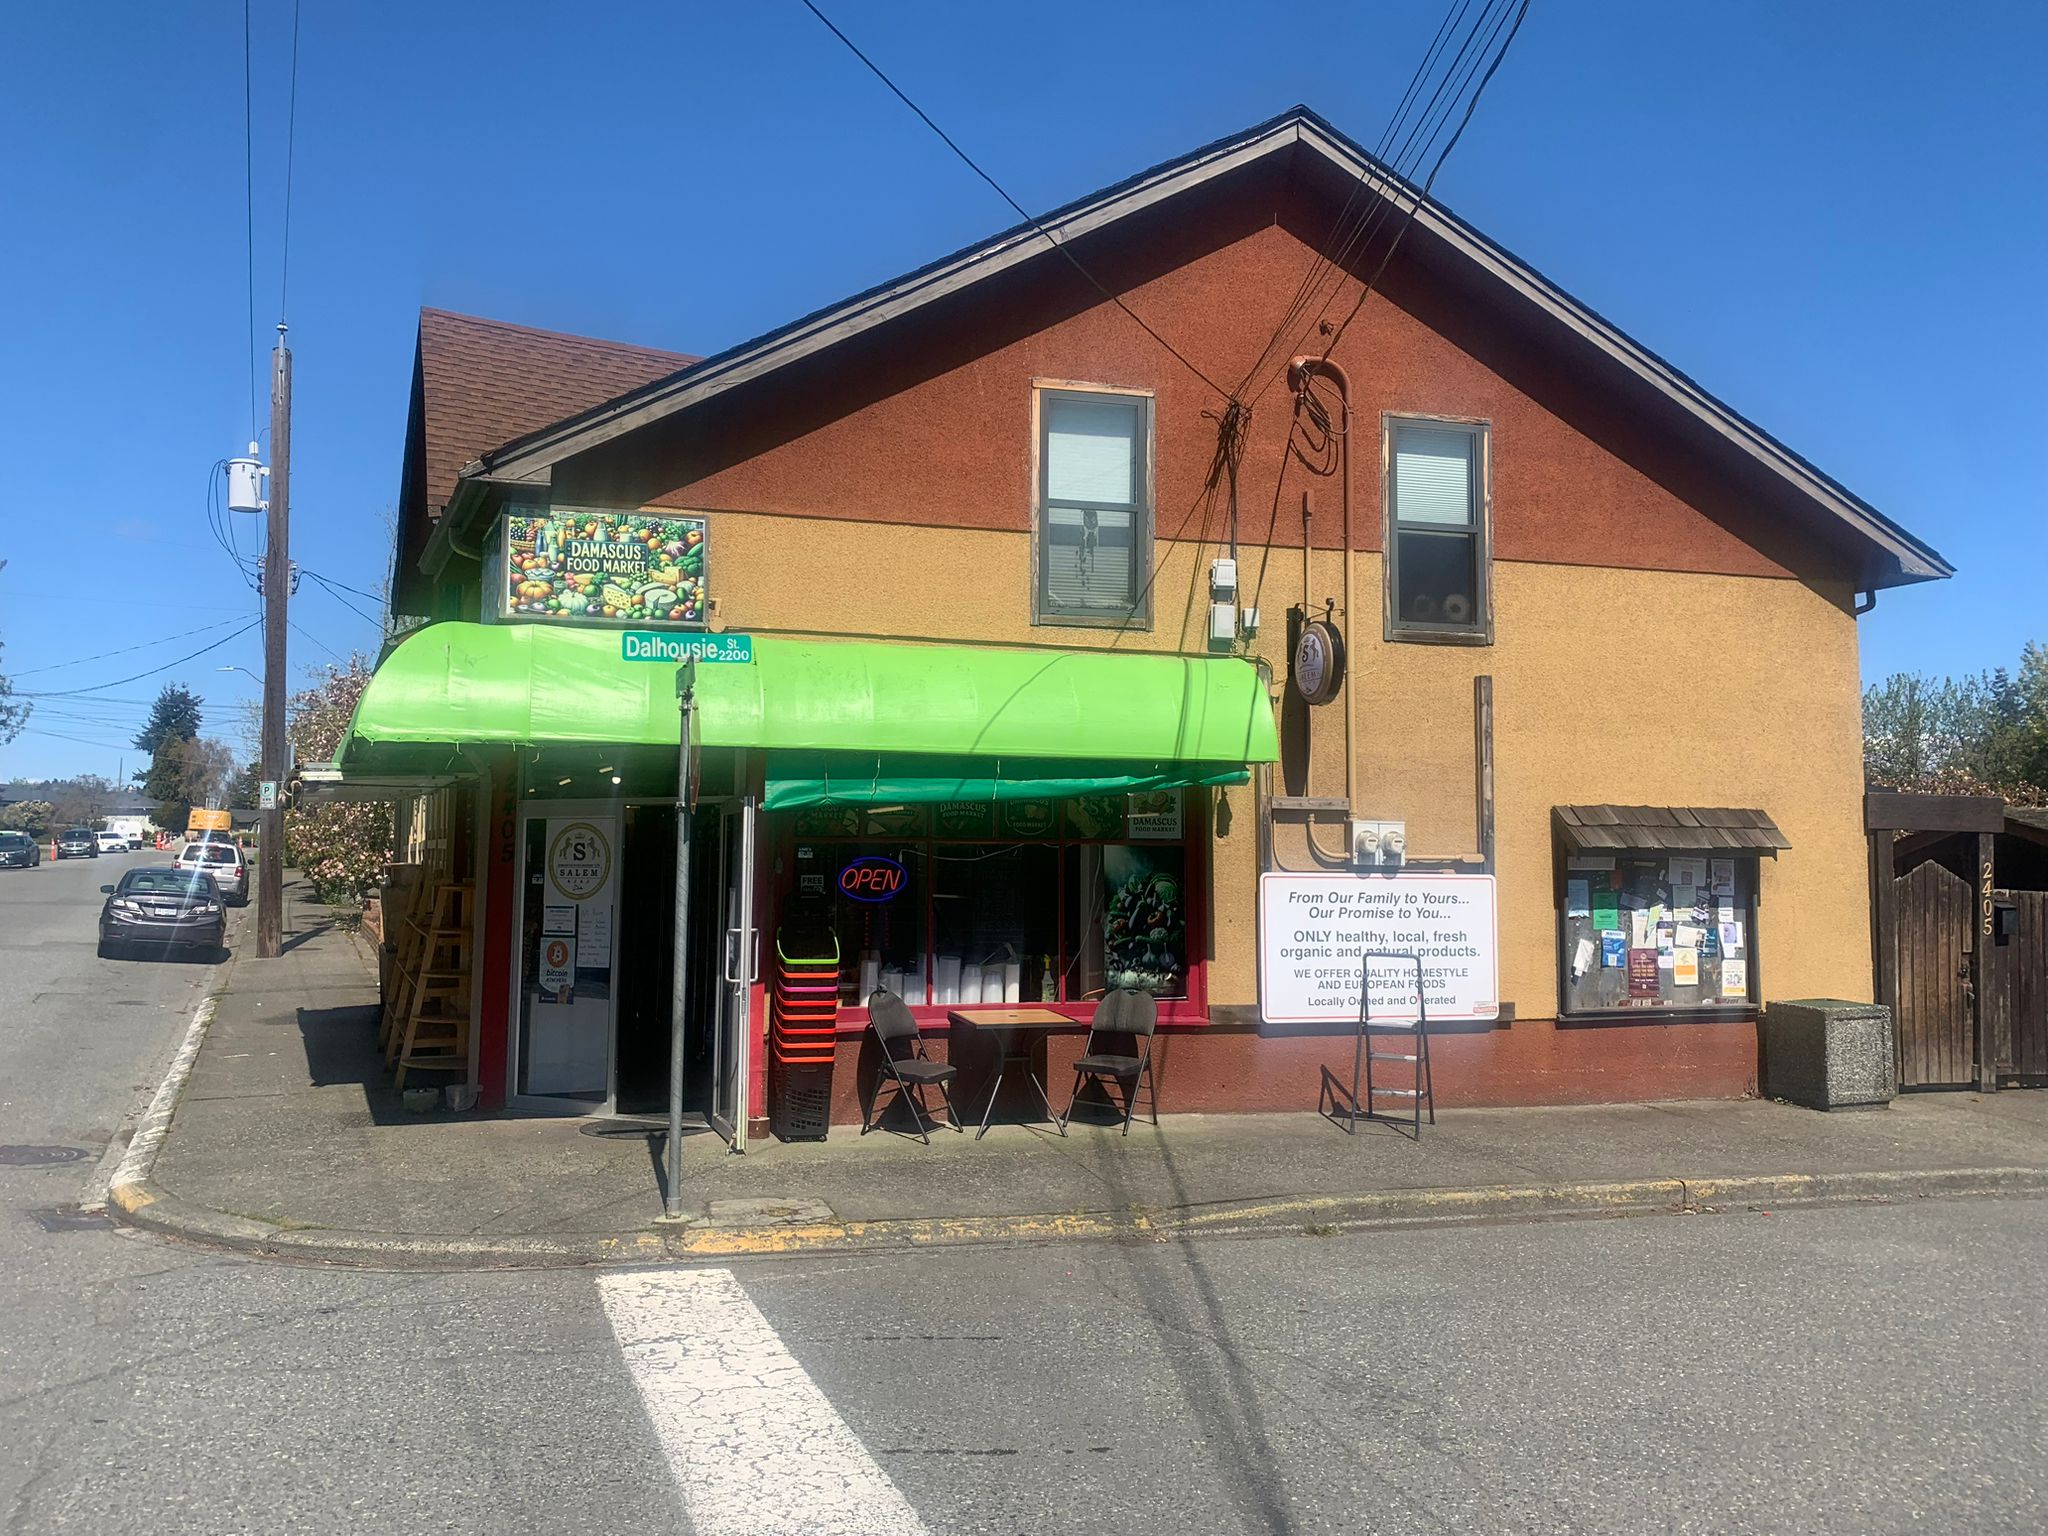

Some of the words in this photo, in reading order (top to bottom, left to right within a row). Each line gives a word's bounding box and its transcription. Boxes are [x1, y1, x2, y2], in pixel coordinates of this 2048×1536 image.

[571, 541, 642, 561] DAMASCUS
[566, 557, 600, 572] FOOD
[603, 559, 646, 575] MARKET
[626, 636, 718, 660] Dalhousie
[726, 638, 740, 650] St.
[718, 650, 750, 661] 2200
[264, 786, 270, 795] P
[939, 802, 987, 813] DAMASCUS
[1133, 817, 1177, 826] DAMASCUS
[573, 842, 586, 861] S
[559, 868, 598, 877] SALEM
[841, 868, 901, 890] OPEN
[802, 876, 823, 885] FREE
[1288, 891, 1324, 904] From
[1329, 891, 1354, 904] Our
[1358, 891, 1400, 907] Family
[1405, 892, 1418, 904] to
[1422, 892, 1470, 905] Yours...
[1982, 862, 1993, 935] 2405
[1309, 906, 1335, 919] Our
[1338, 906, 1394, 919] Promise
[1398, 907, 1412, 919] to
[1416, 907, 1451, 919] You...
[1293, 930, 1332, 943] ONLY
[1336, 930, 1389, 945] healthy,
[1393, 930, 1429, 945] local,
[1433, 930, 1467, 943] fresh
[1280, 945, 1332, 961] organic
[1337, 945, 1362, 958] and
[1418, 945, 1481, 961] products.
[1294, 968, 1312, 979] WE
[1314, 968, 1351, 979] OFFER
[1403, 967, 1469, 978] HOMESTYLE
[1318, 980, 1342, 990] AND
[1308, 996, 1345, 1008] Locally
[1387, 995, 1406, 1006] and
[1409, 995, 1456, 1006] Oerated
